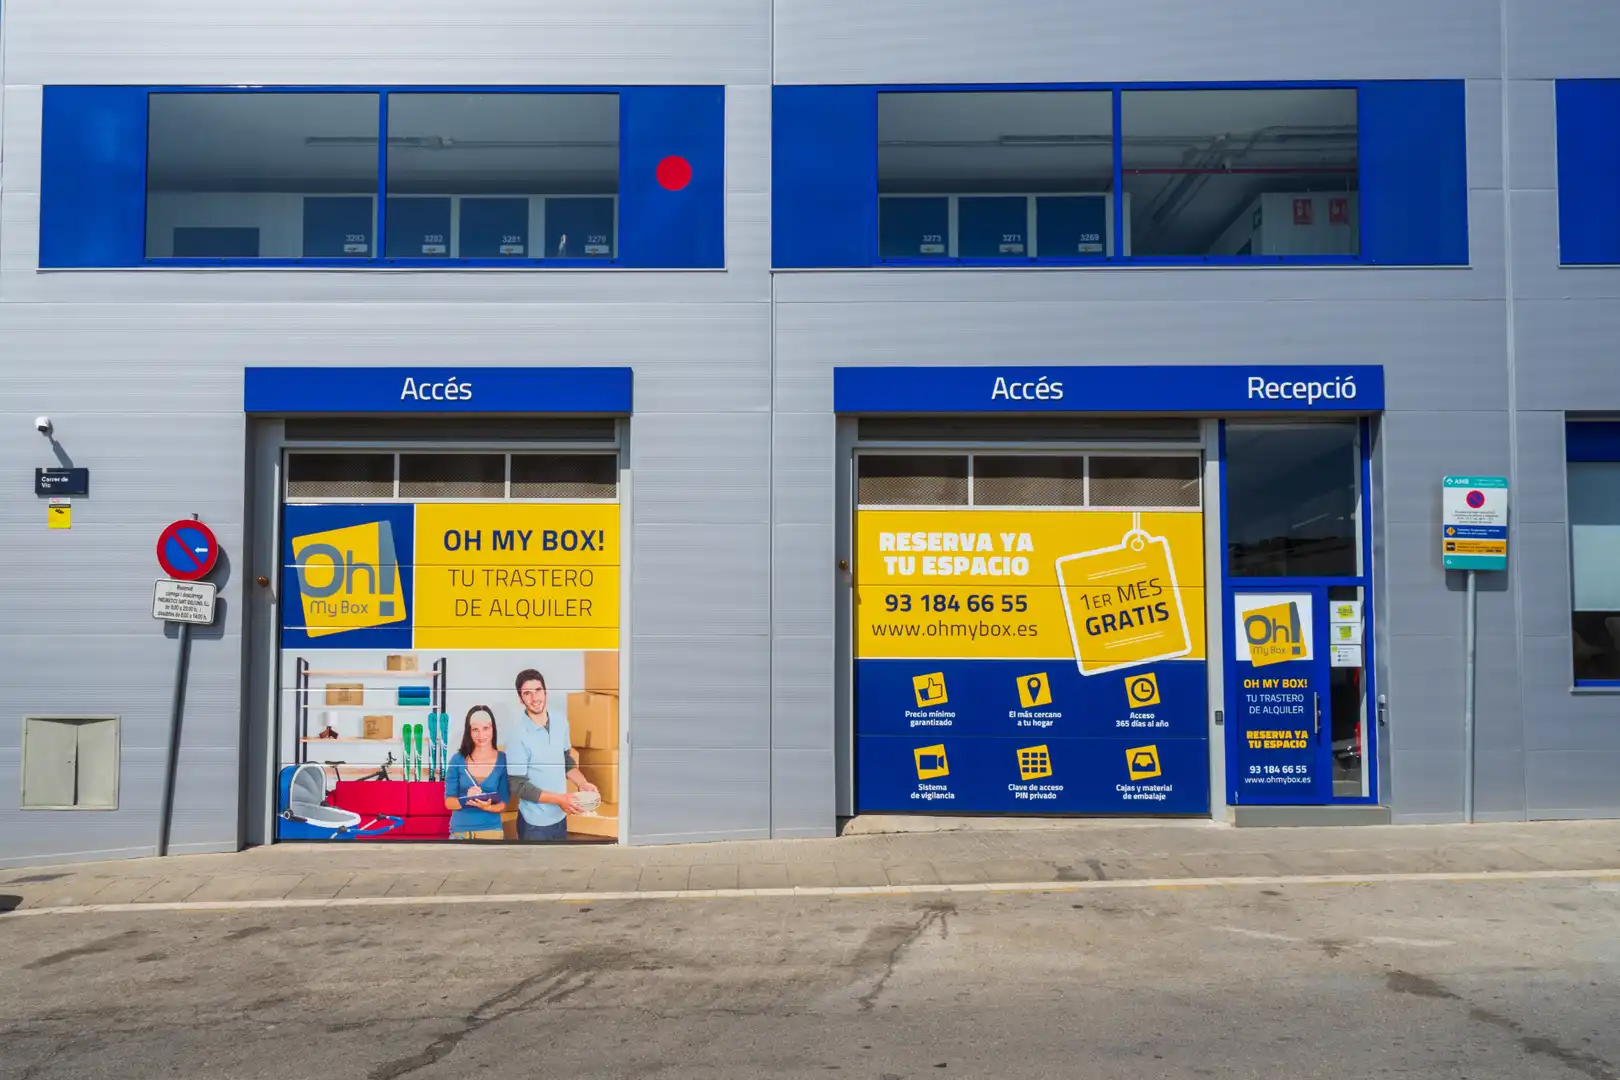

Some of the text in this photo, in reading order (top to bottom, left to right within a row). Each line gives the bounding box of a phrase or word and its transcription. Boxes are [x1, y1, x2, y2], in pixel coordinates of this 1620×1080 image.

[424, 235, 443, 243] 3282
[502, 235, 521, 243] 3281
[922, 234, 942, 242] 3273
[1002, 234, 1021, 242] 3271
[1080, 234, 1100, 242] 3269
[400, 376, 473, 400] Accés
[991, 375, 1064, 400] Accés
[1247, 375, 1357, 405] Recepció
[444, 530, 605, 552] OH MY BOX!
[880, 532, 1034, 552] RESERVA YA
[884, 556, 1029, 576] TU ESPACIO
[448, 569, 594, 588] TU TRASTERO
[1080, 578, 1162, 610] 1ER MES
[885, 594, 1028, 612] 93 184 66 55
[310, 600, 369, 617] My Box
[455, 598, 592, 620] DE ALQUILER
[1086, 602, 1169, 636] GRATIS
[872, 620, 1038, 641] www.ohmybox.es
[1253, 646, 1286, 656] My Box
[1244, 678, 1308, 688] OH MY BOX!
[1246, 694, 1304, 702] TU TRASTERO
[905, 710, 956, 718] Precio mínimo
[1018, 710, 1032, 718] más
[1248, 706, 1304, 715] DE ALQUILER
[910, 719, 952, 728] garantizado
[1032, 720, 1054, 728] hogar
[1131, 720, 1146, 728] días
[1147, 720, 1154, 728] al
[1156, 720, 1169, 728] año
[1246, 730, 1308, 739] RESERVA YA
[1248, 740, 1307, 748] TU ESPACIO
[1250, 766, 1308, 774] 93 184 66 55
[1244, 776, 1312, 784] www.ohmybox.es
[1116, 784, 1136, 792] Cajas
[1142, 784, 1172, 792] material
[921, 792, 955, 800] vigilancia
[1030, 792, 1056, 800] privado
[1133, 793, 1166, 801] embalaje
